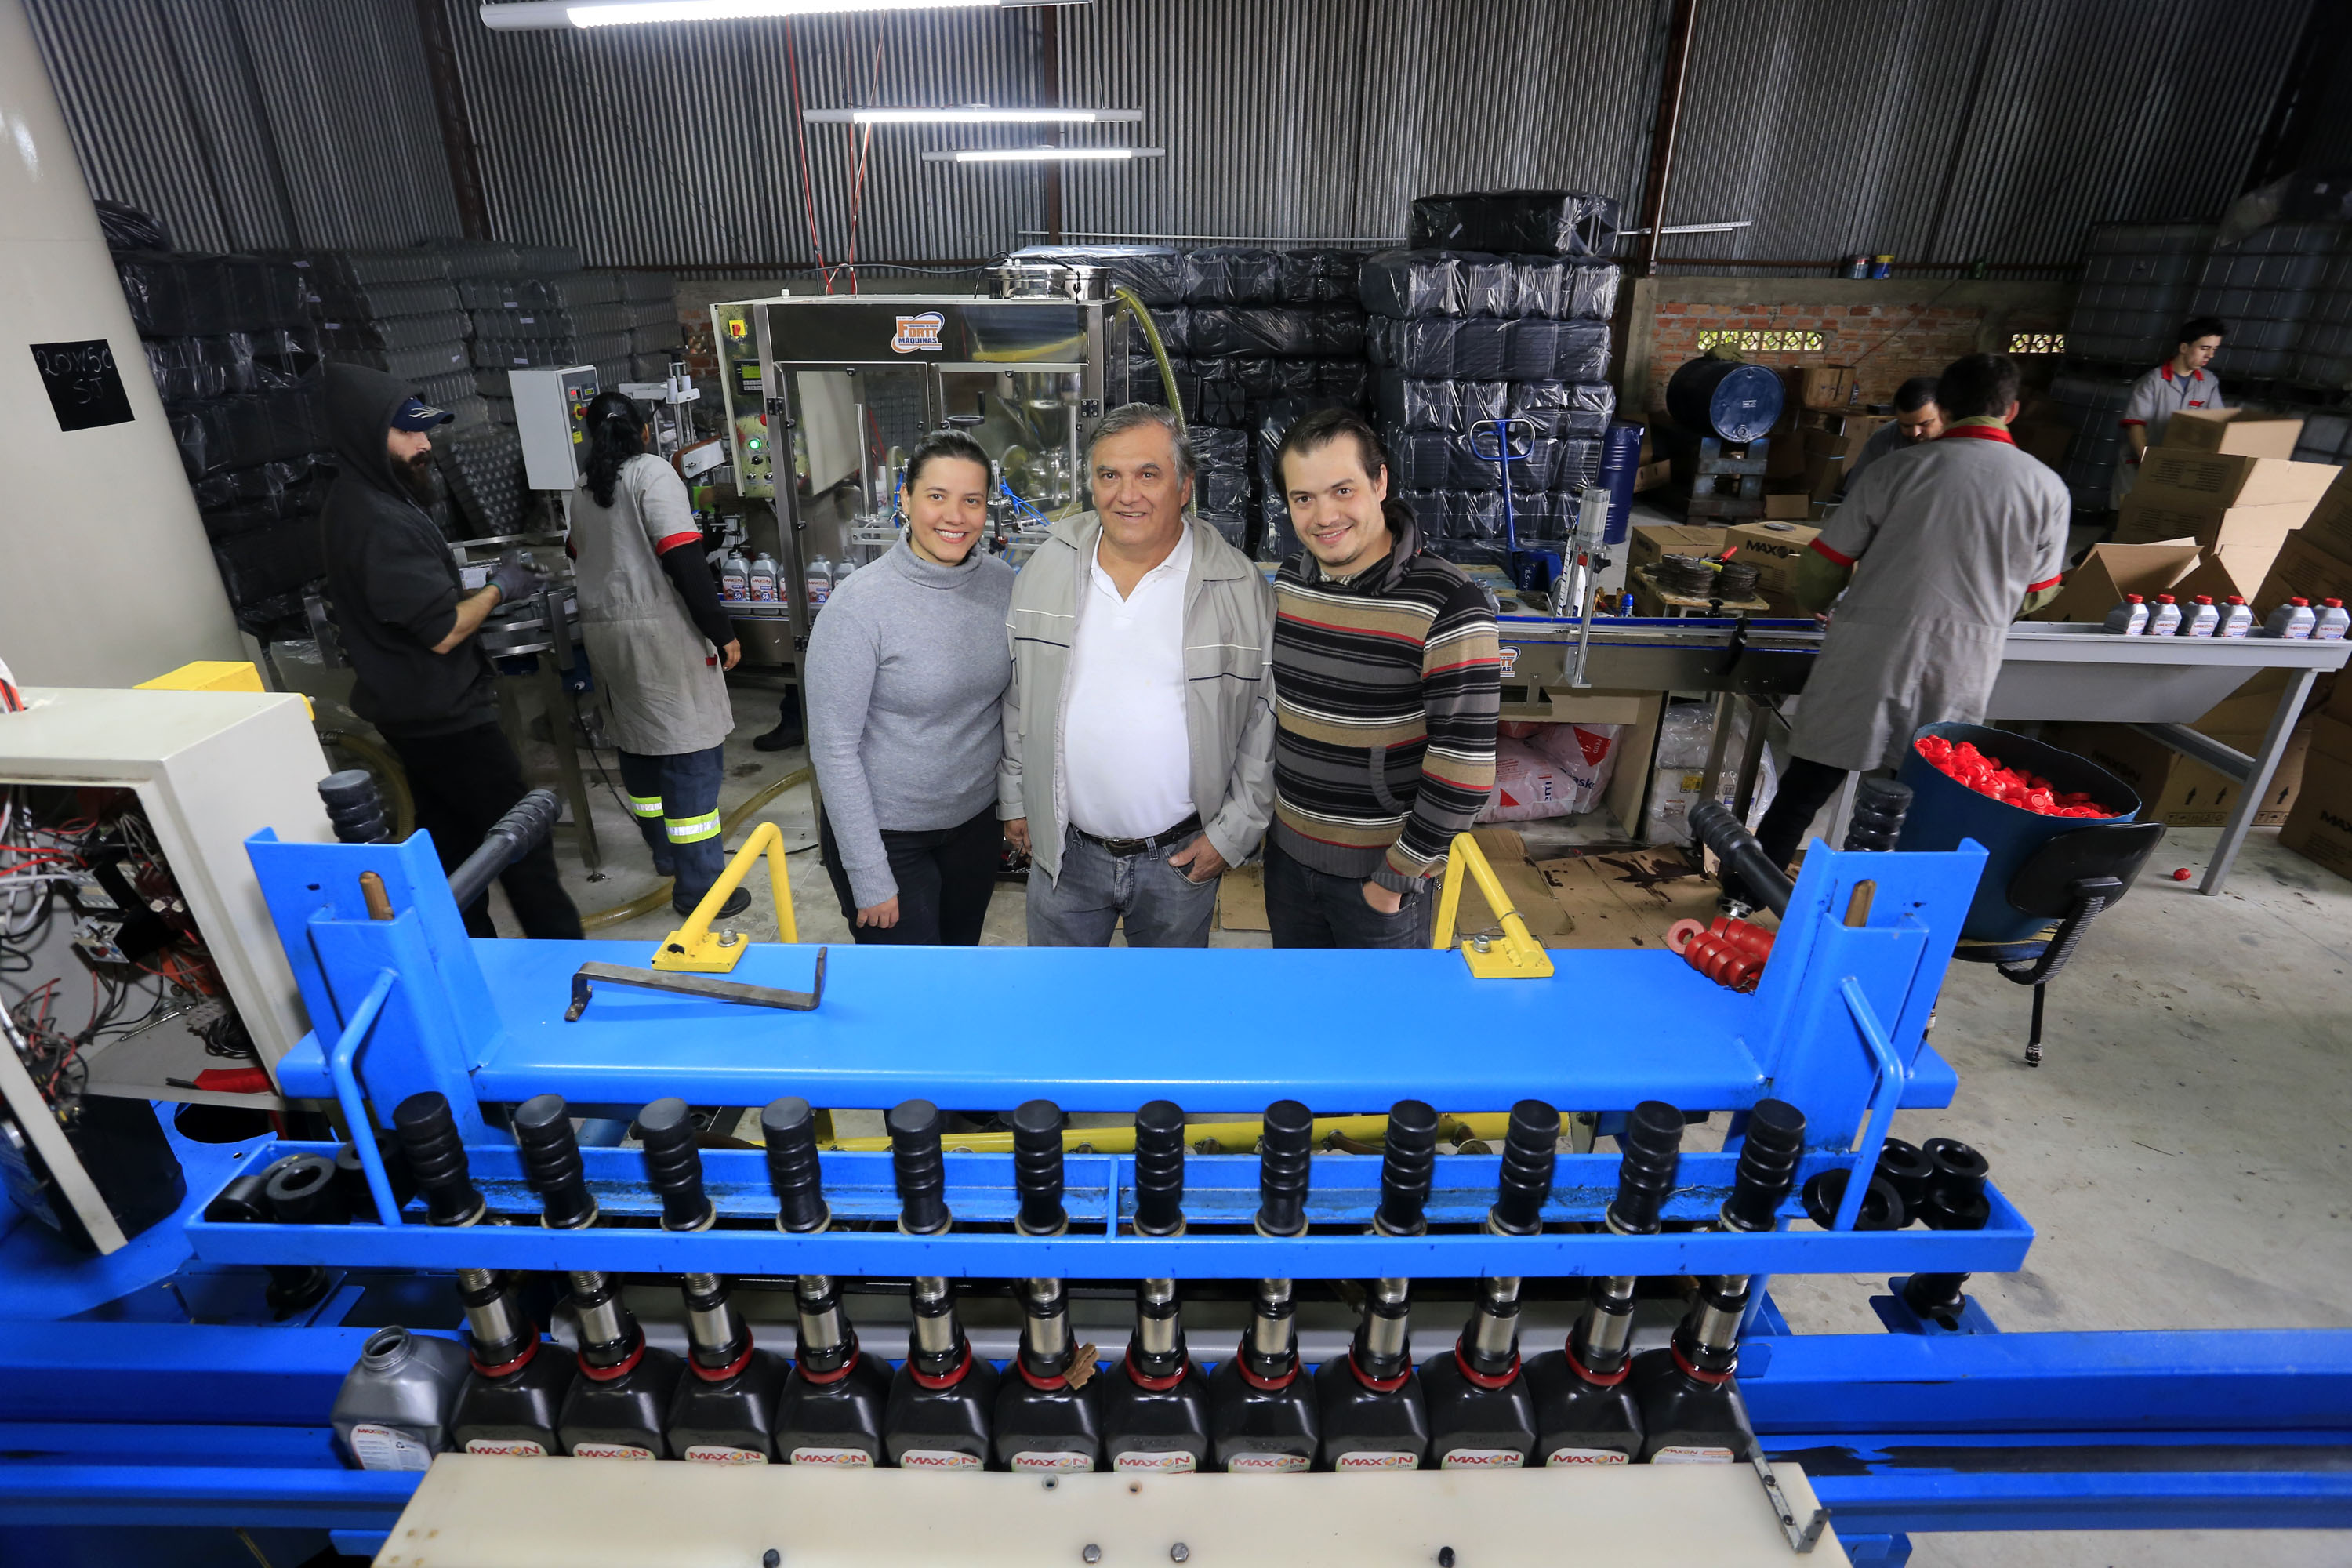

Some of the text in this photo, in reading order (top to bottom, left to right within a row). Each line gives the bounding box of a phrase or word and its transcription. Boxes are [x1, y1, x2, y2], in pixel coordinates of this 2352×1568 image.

[470, 1446, 540, 1456] MAXON
[577, 1448, 648, 1458] MAXON
[689, 1451, 761, 1461] MAXON
[795, 1454, 866, 1464] MAXON
[906, 1456, 977, 1466] MAXON
[1016, 1457, 1087, 1467] MAXON
[1119, 1456, 1190, 1467] MAXON
[1233, 1457, 1305, 1468] MAXON
[1341, 1456, 1413, 1466] MAXON
[1447, 1454, 1519, 1464] MAXON
[1553, 1455, 1624, 1464] MAXON
